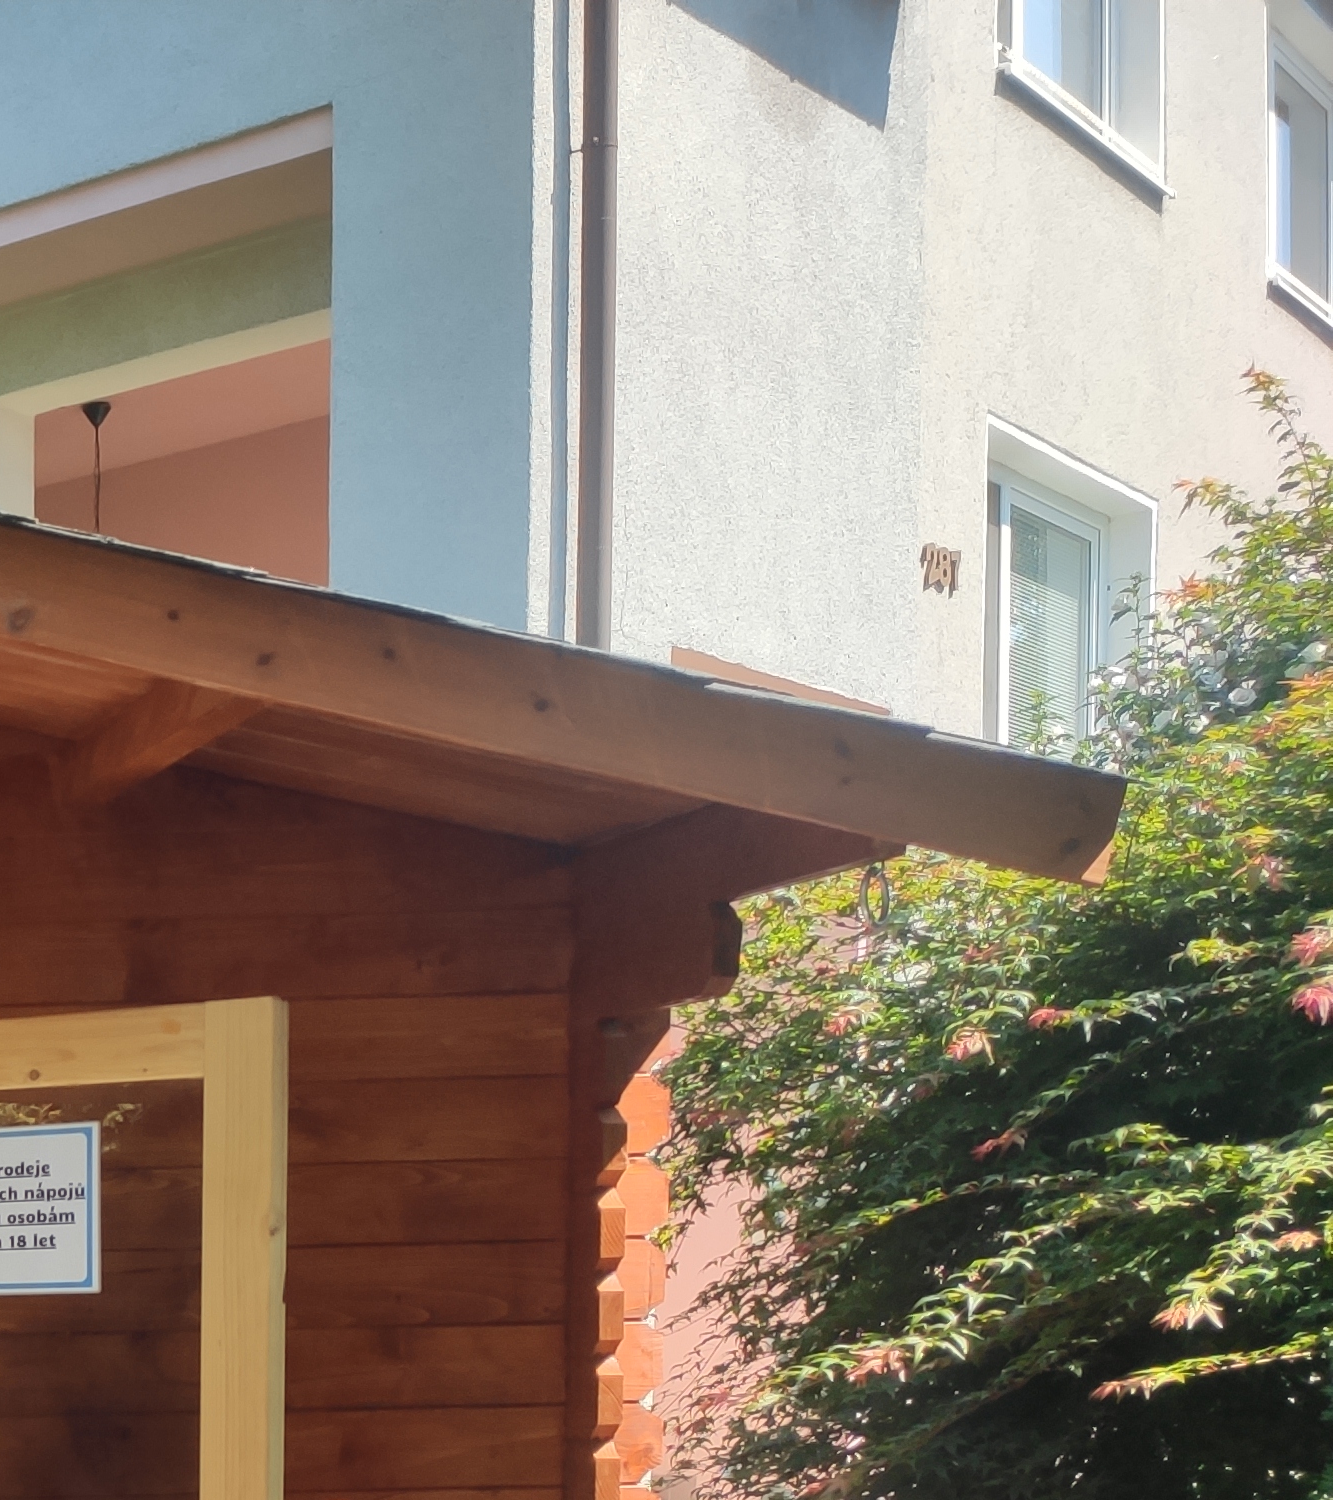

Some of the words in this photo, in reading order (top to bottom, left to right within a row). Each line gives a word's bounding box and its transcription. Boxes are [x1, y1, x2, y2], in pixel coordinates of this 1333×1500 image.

[923, 542, 961, 591] 287
[24, 1182, 86, 1202] nápojů
[7, 1206, 75, 1225] osobám
[9, 1234, 27, 1249] 18
[33, 1233, 57, 1249] let
